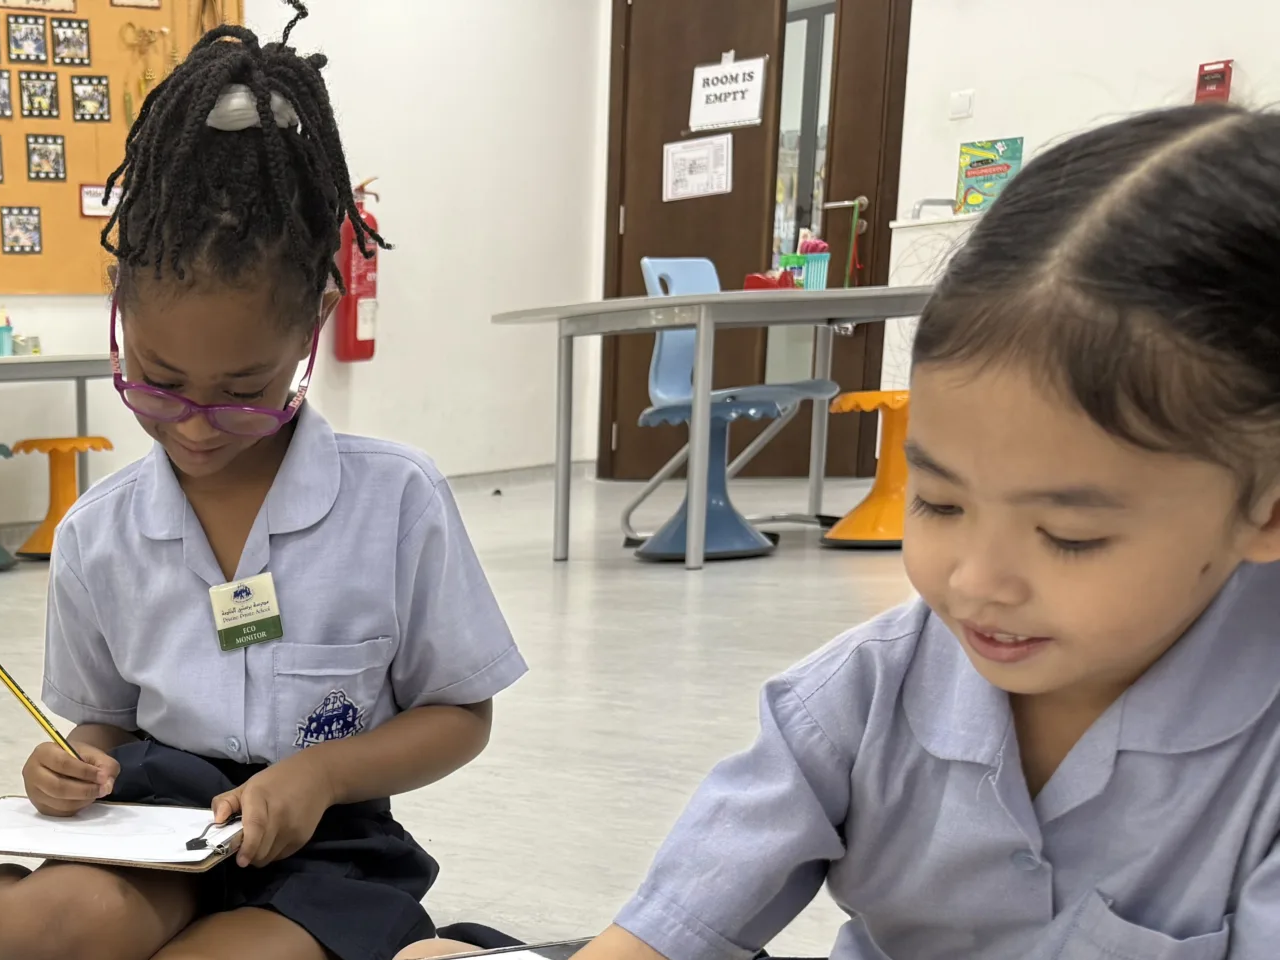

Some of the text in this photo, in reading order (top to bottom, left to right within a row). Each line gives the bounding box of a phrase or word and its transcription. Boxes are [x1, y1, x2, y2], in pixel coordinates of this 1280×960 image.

[702, 71, 754, 89] ROOM IS
[704, 89, 749, 105] EMPTY
[242, 625, 256, 634] ECO
[235, 631, 267, 644] MONITOR
